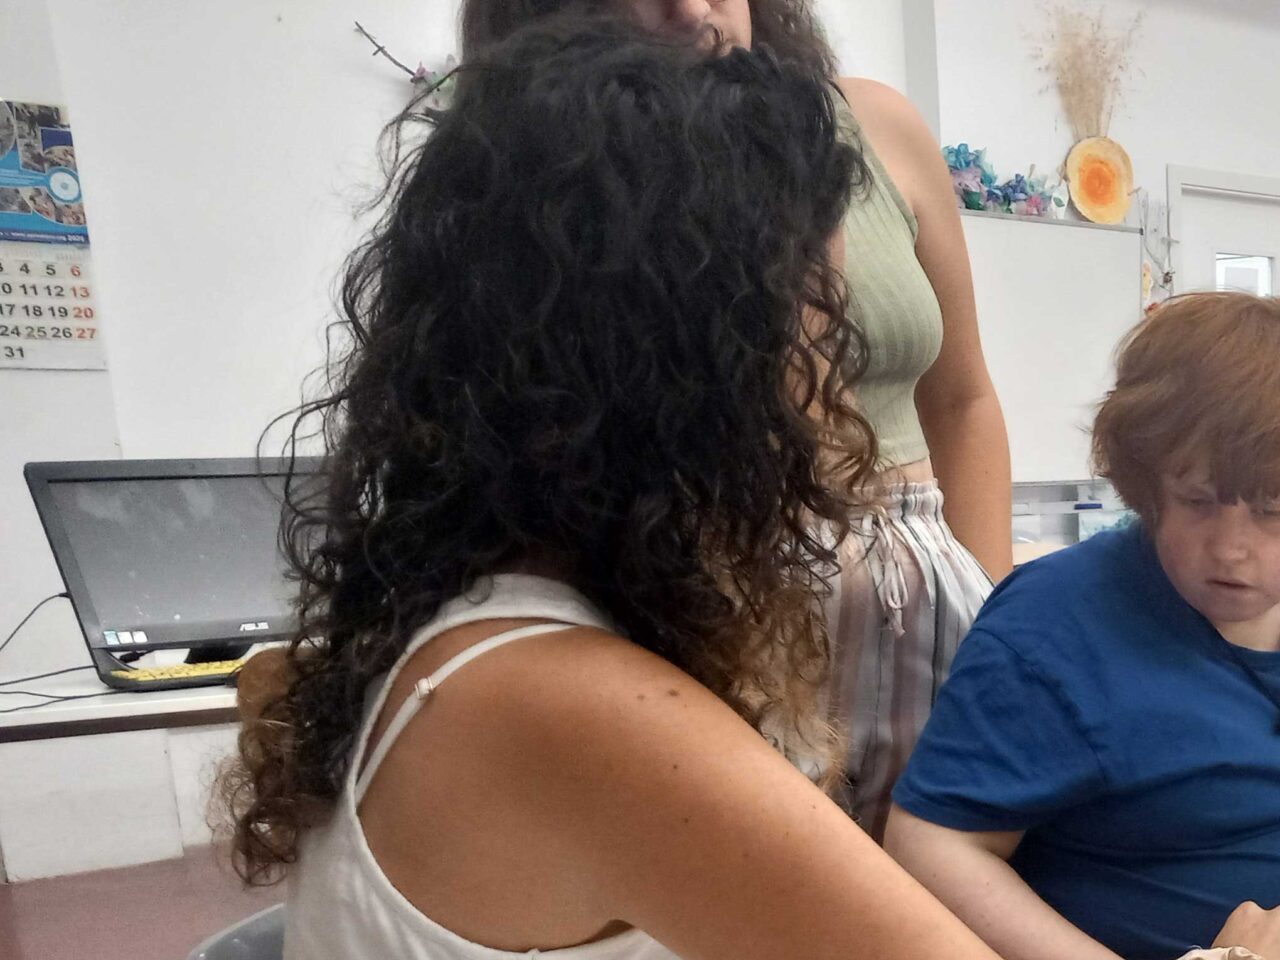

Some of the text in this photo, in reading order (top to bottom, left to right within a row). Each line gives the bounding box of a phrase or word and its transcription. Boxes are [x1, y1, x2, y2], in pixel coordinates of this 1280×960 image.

[20, 263, 30, 274] 4
[46, 264, 56, 276] 5
[70, 265, 80, 277] 6
[18, 283, 38, 296] 11
[43, 285, 65, 297] 12
[71, 286, 90, 298] 13
[21, 305, 43, 317] 18
[47, 306, 69, 318] 19
[72, 307, 95, 319] 20
[0, 325, 97, 339] 24 25 26 27
[4, 346, 25, 358] 31
[239, 622, 269, 631] ASUS
